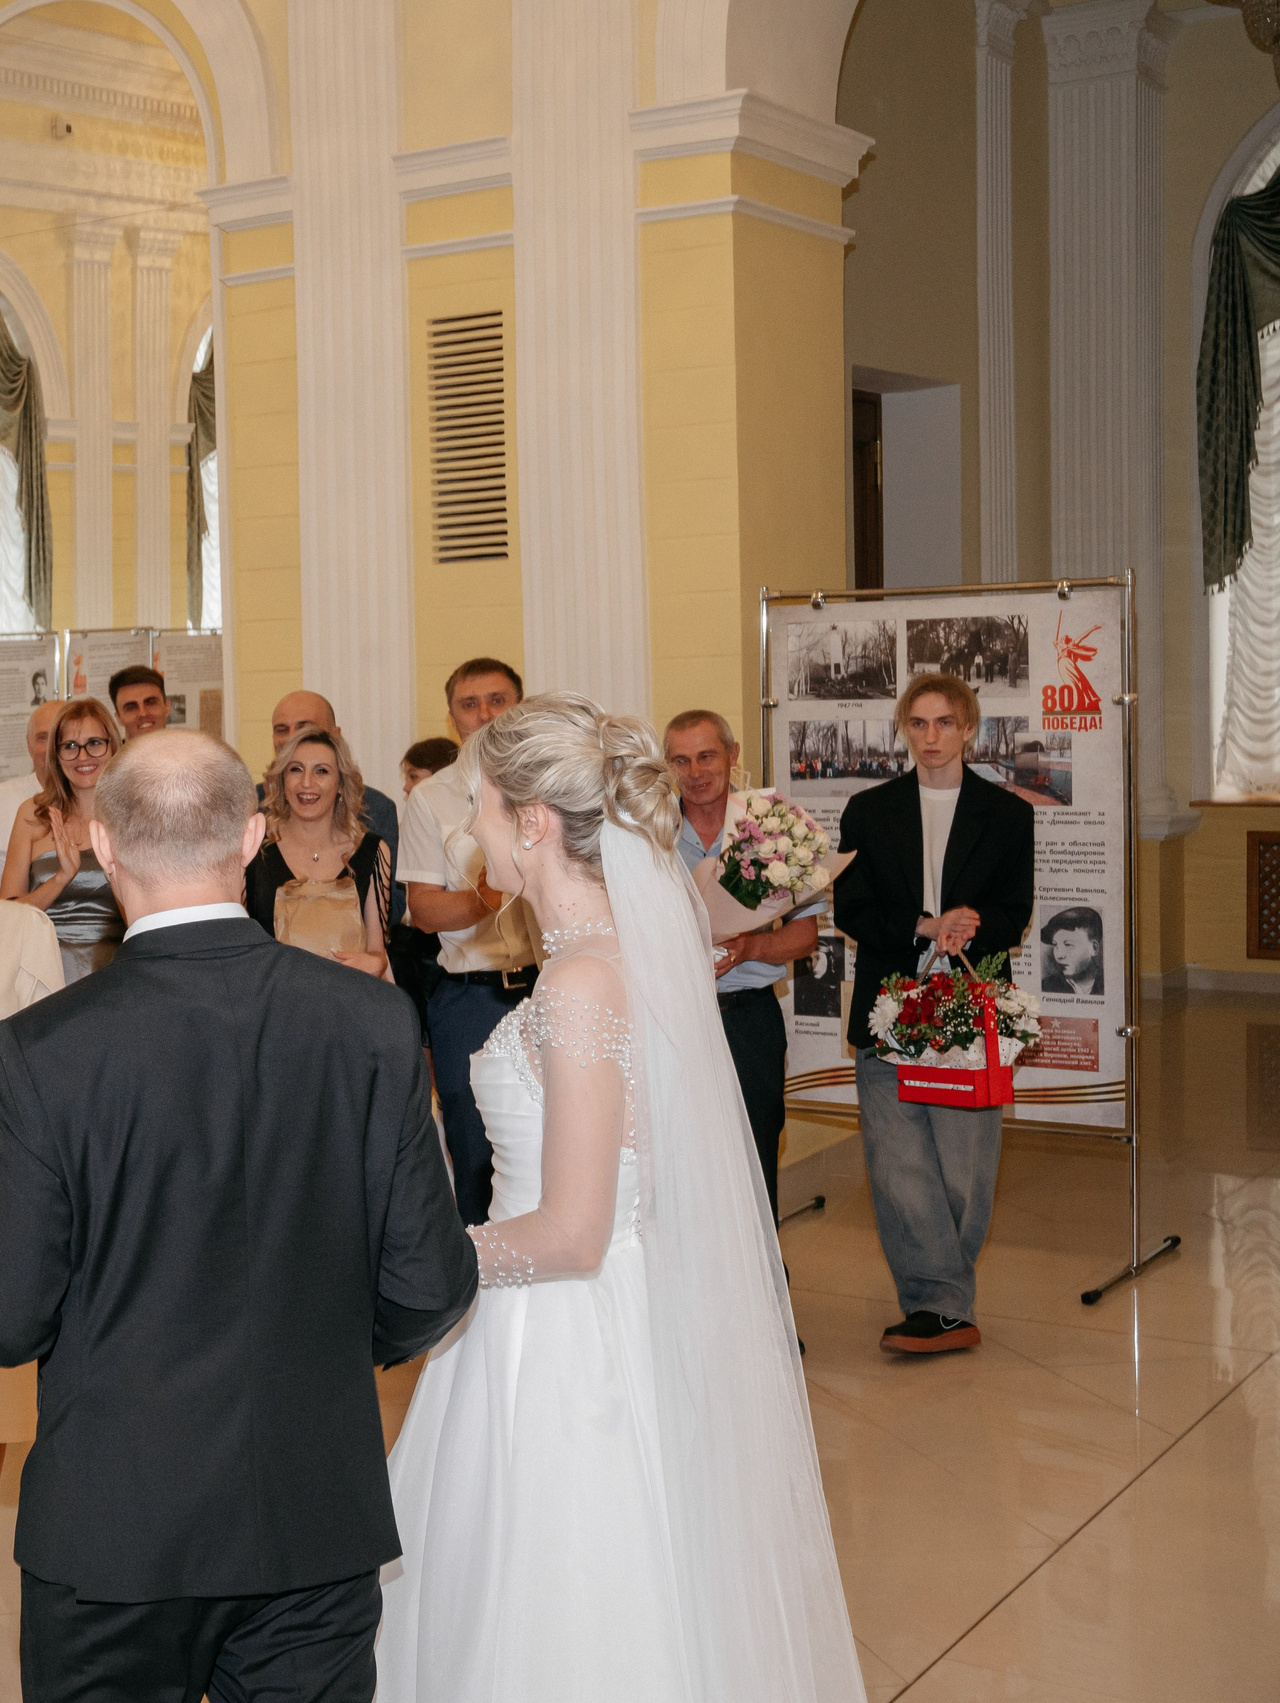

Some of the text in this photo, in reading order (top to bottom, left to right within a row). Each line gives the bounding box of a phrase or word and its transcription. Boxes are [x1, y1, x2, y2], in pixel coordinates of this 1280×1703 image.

[1042, 684, 1074, 711] 80
[1042, 716, 1103, 732] ПОБЕДА!
[1049, 849, 1105, 857] бомбардировок
[1049, 866, 1068, 874] Здесь
[1075, 887, 1107, 895] Вавилов,
[1041, 996, 1105, 1005] Геннадий Вавилов
[794, 1029, 838, 1037] Колесниченко
